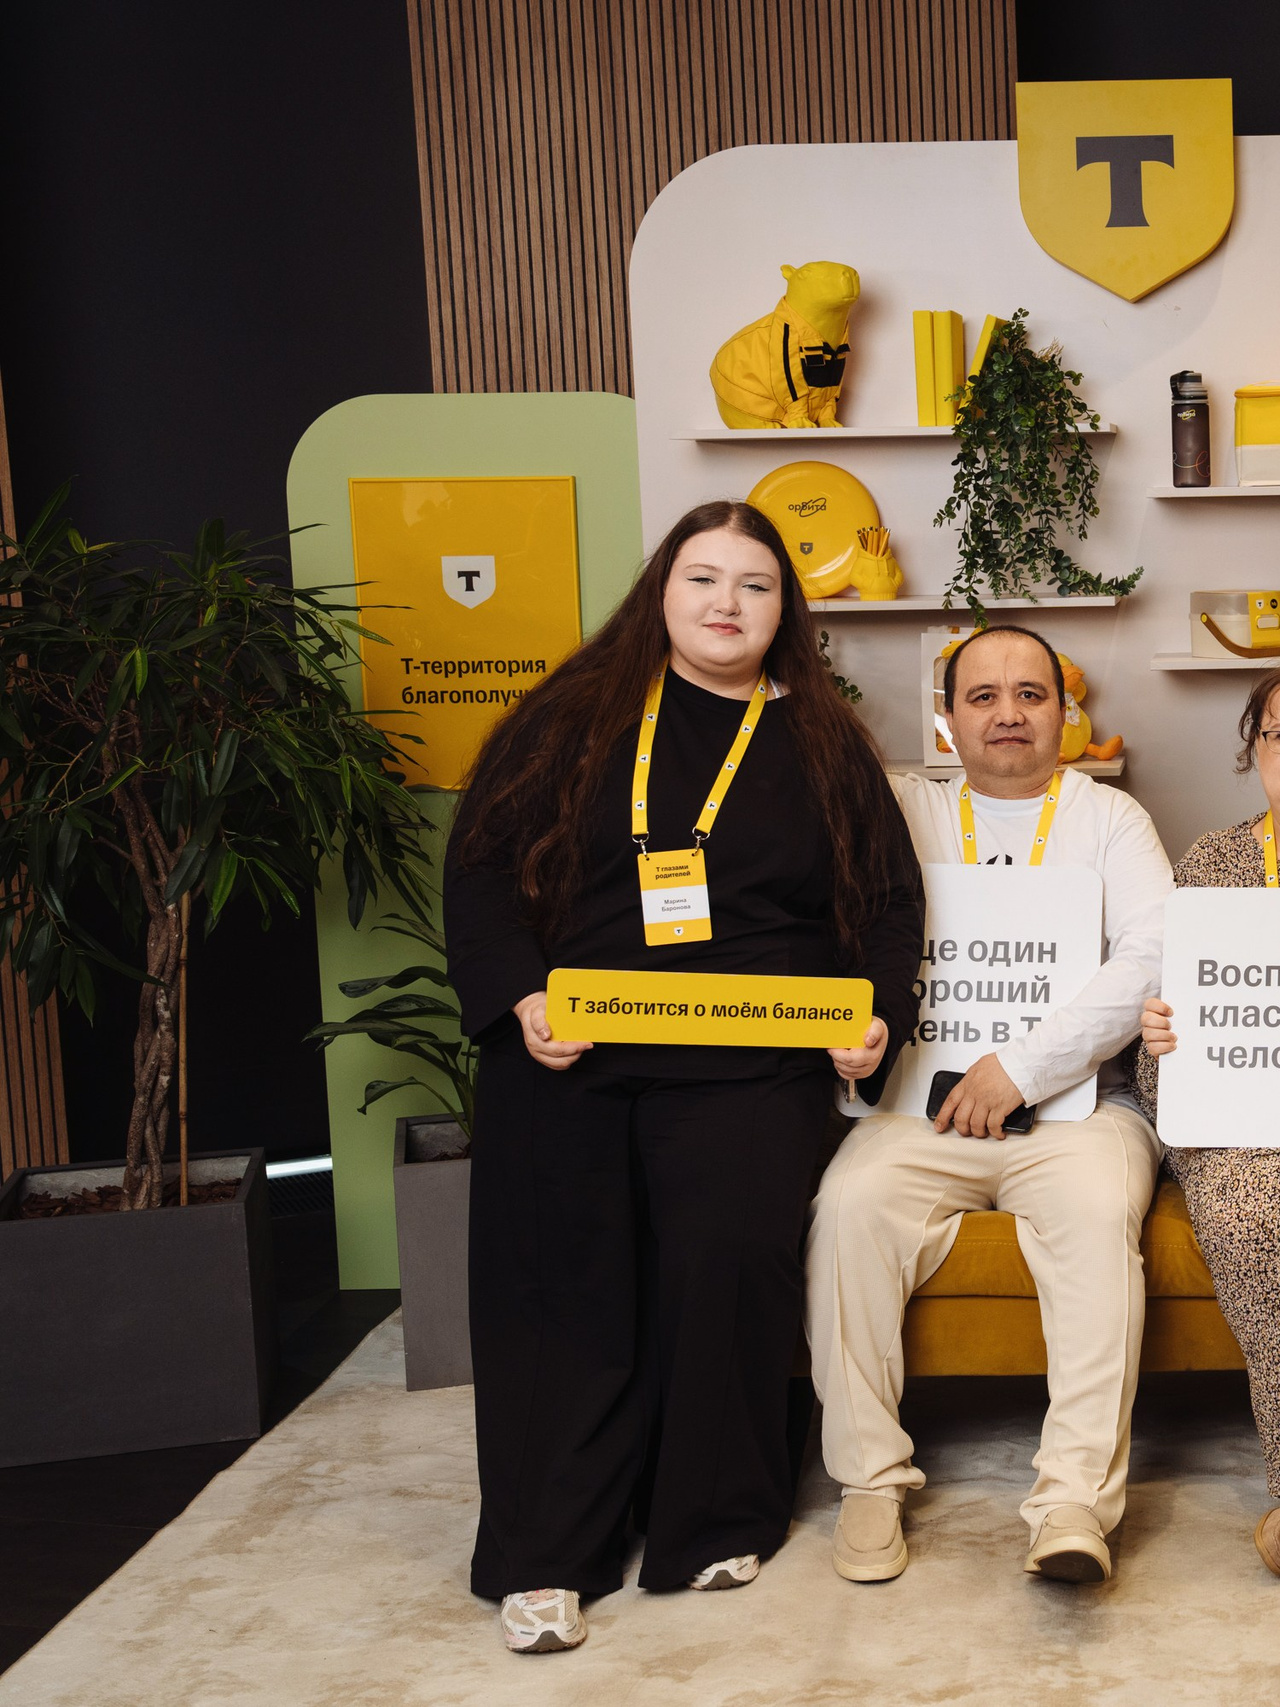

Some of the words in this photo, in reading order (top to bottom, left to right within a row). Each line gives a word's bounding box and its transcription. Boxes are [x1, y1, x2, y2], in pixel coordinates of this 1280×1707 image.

[1074, 134, 1176, 229] Т
[457, 570, 481, 592] Т
[400, 657, 547, 679] Т-территория
[401, 686, 529, 707] благополуч
[655, 870, 692, 880] родителей
[661, 864, 689, 872] глазами
[661, 904, 692, 912] Баронова
[967, 939, 1057, 968] один
[912, 974, 1050, 1009] ороший
[568, 997, 581, 1013] Т
[585, 998, 689, 1016] заботится
[694, 1003, 706, 1017] о
[711, 1001, 768, 1019] моём
[772, 1002, 854, 1021] балансе
[907, 1019, 982, 1047] ень
[991, 1021, 1011, 1044] в
